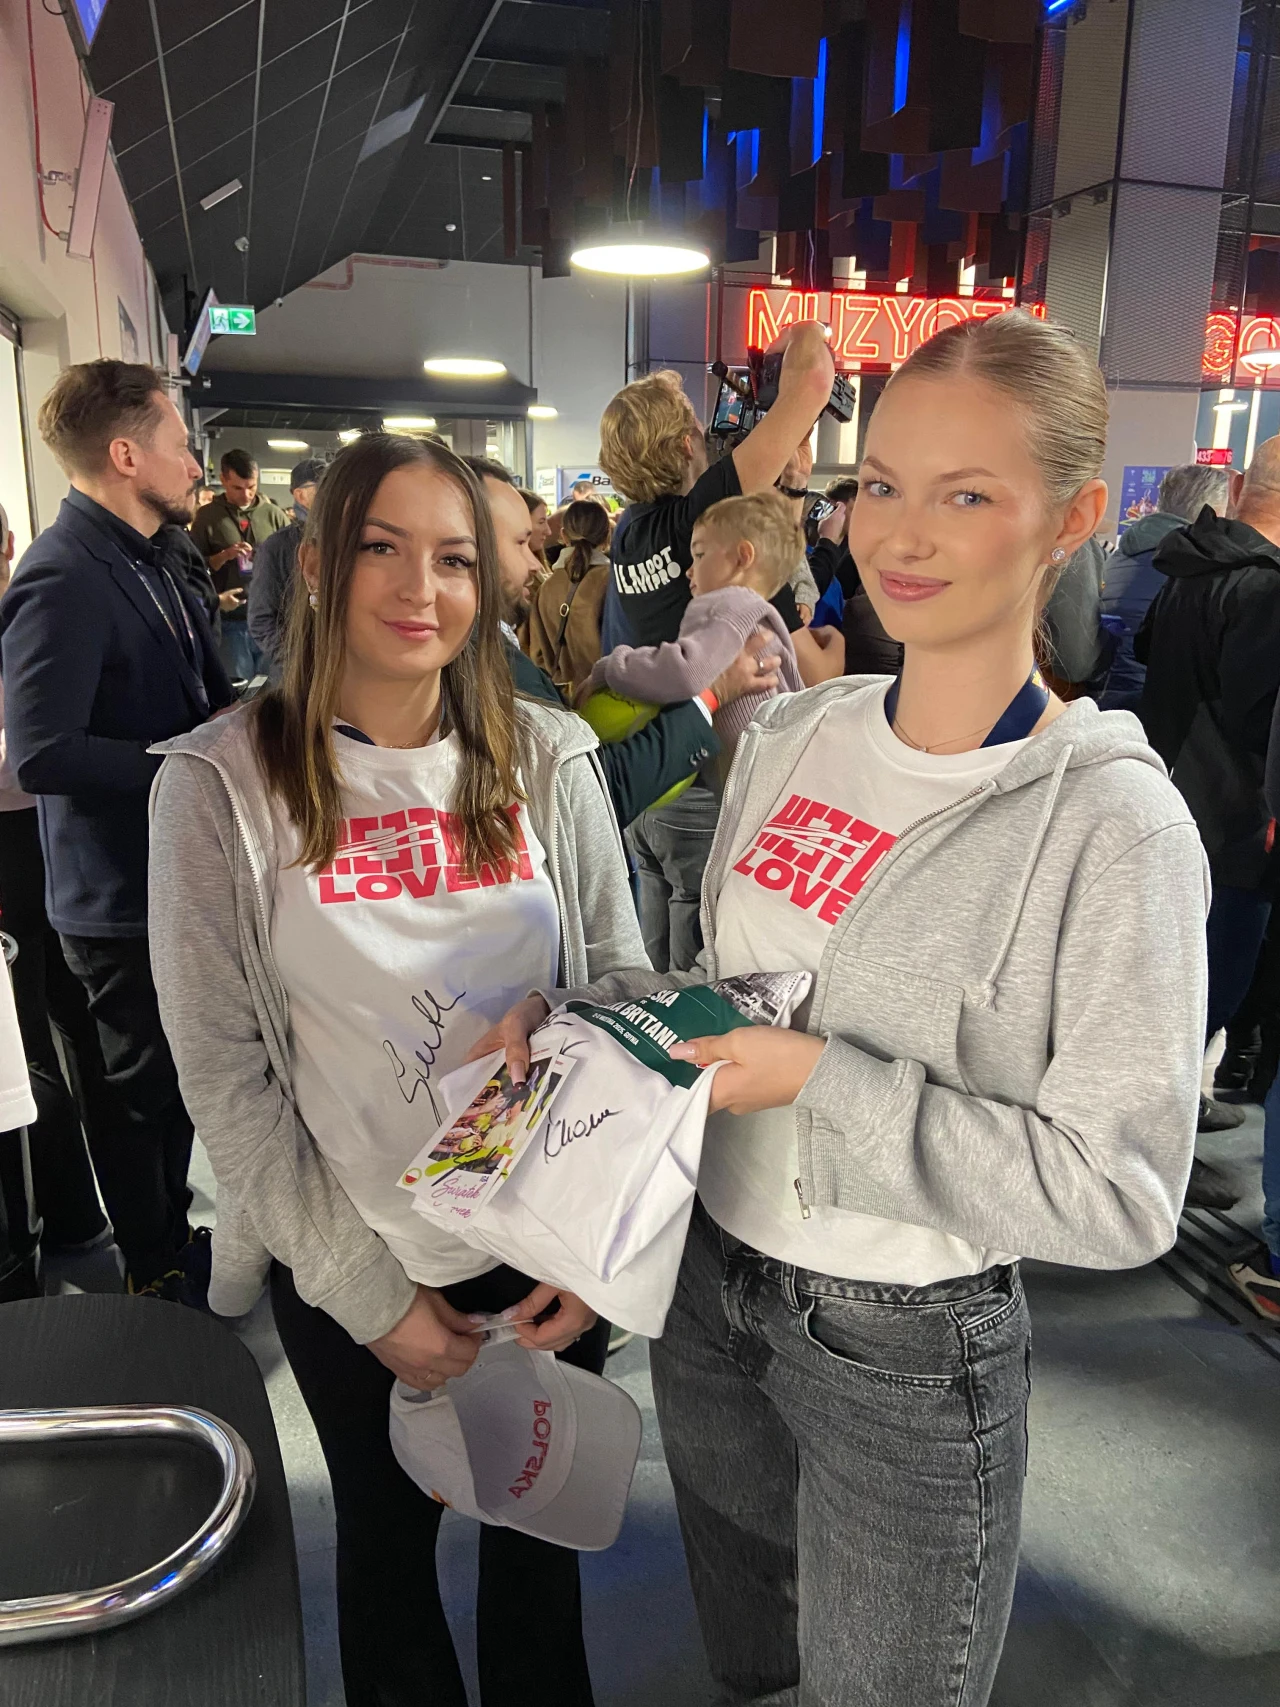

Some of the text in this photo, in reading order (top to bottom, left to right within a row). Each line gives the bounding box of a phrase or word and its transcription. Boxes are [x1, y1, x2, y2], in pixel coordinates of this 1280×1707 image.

[318, 865, 481, 905] LOVE
[732, 847, 854, 926] LOVE
[619, 1003, 686, 1055] BRYTANI
